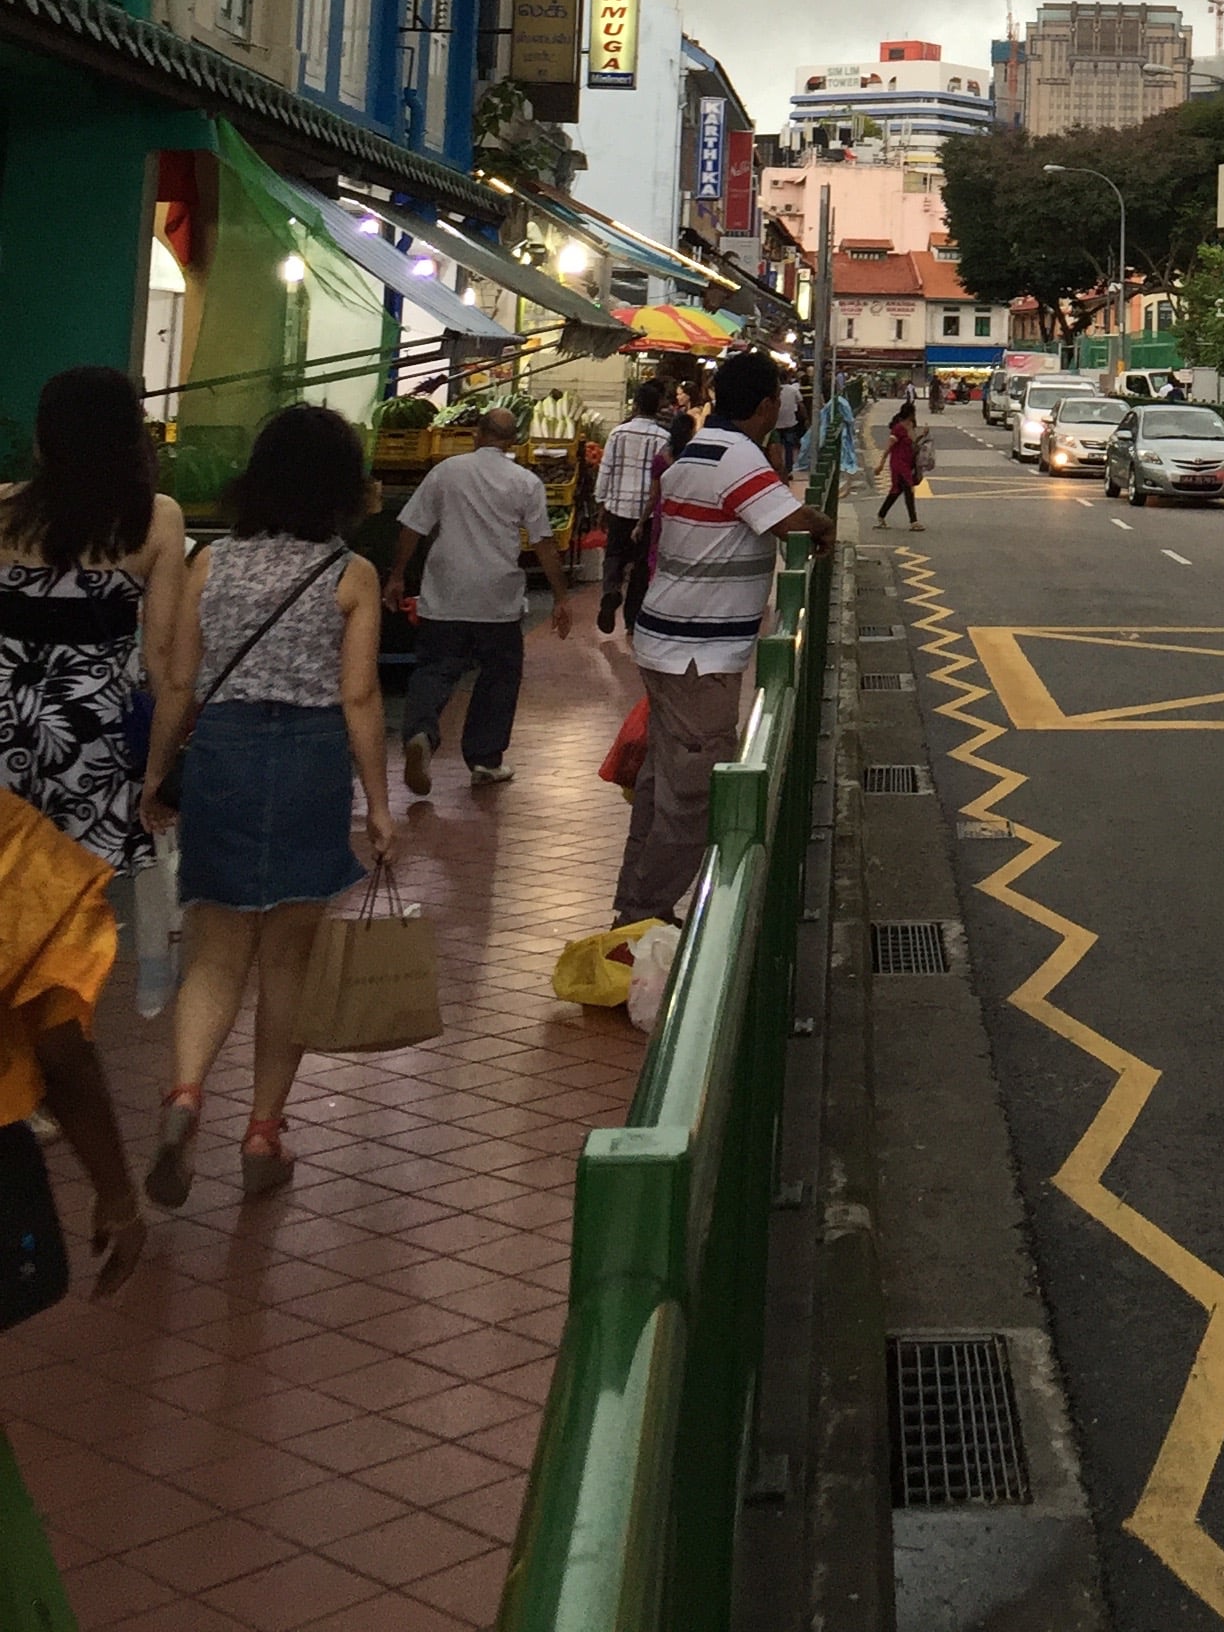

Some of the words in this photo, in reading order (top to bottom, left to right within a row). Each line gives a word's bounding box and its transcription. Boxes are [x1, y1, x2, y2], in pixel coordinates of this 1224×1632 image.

[828, 66, 843, 76] SIM
[844, 65, 860, 75] LIM
[828, 77, 860, 88] TOWER
[701, 102, 721, 196] KARTHIKA
